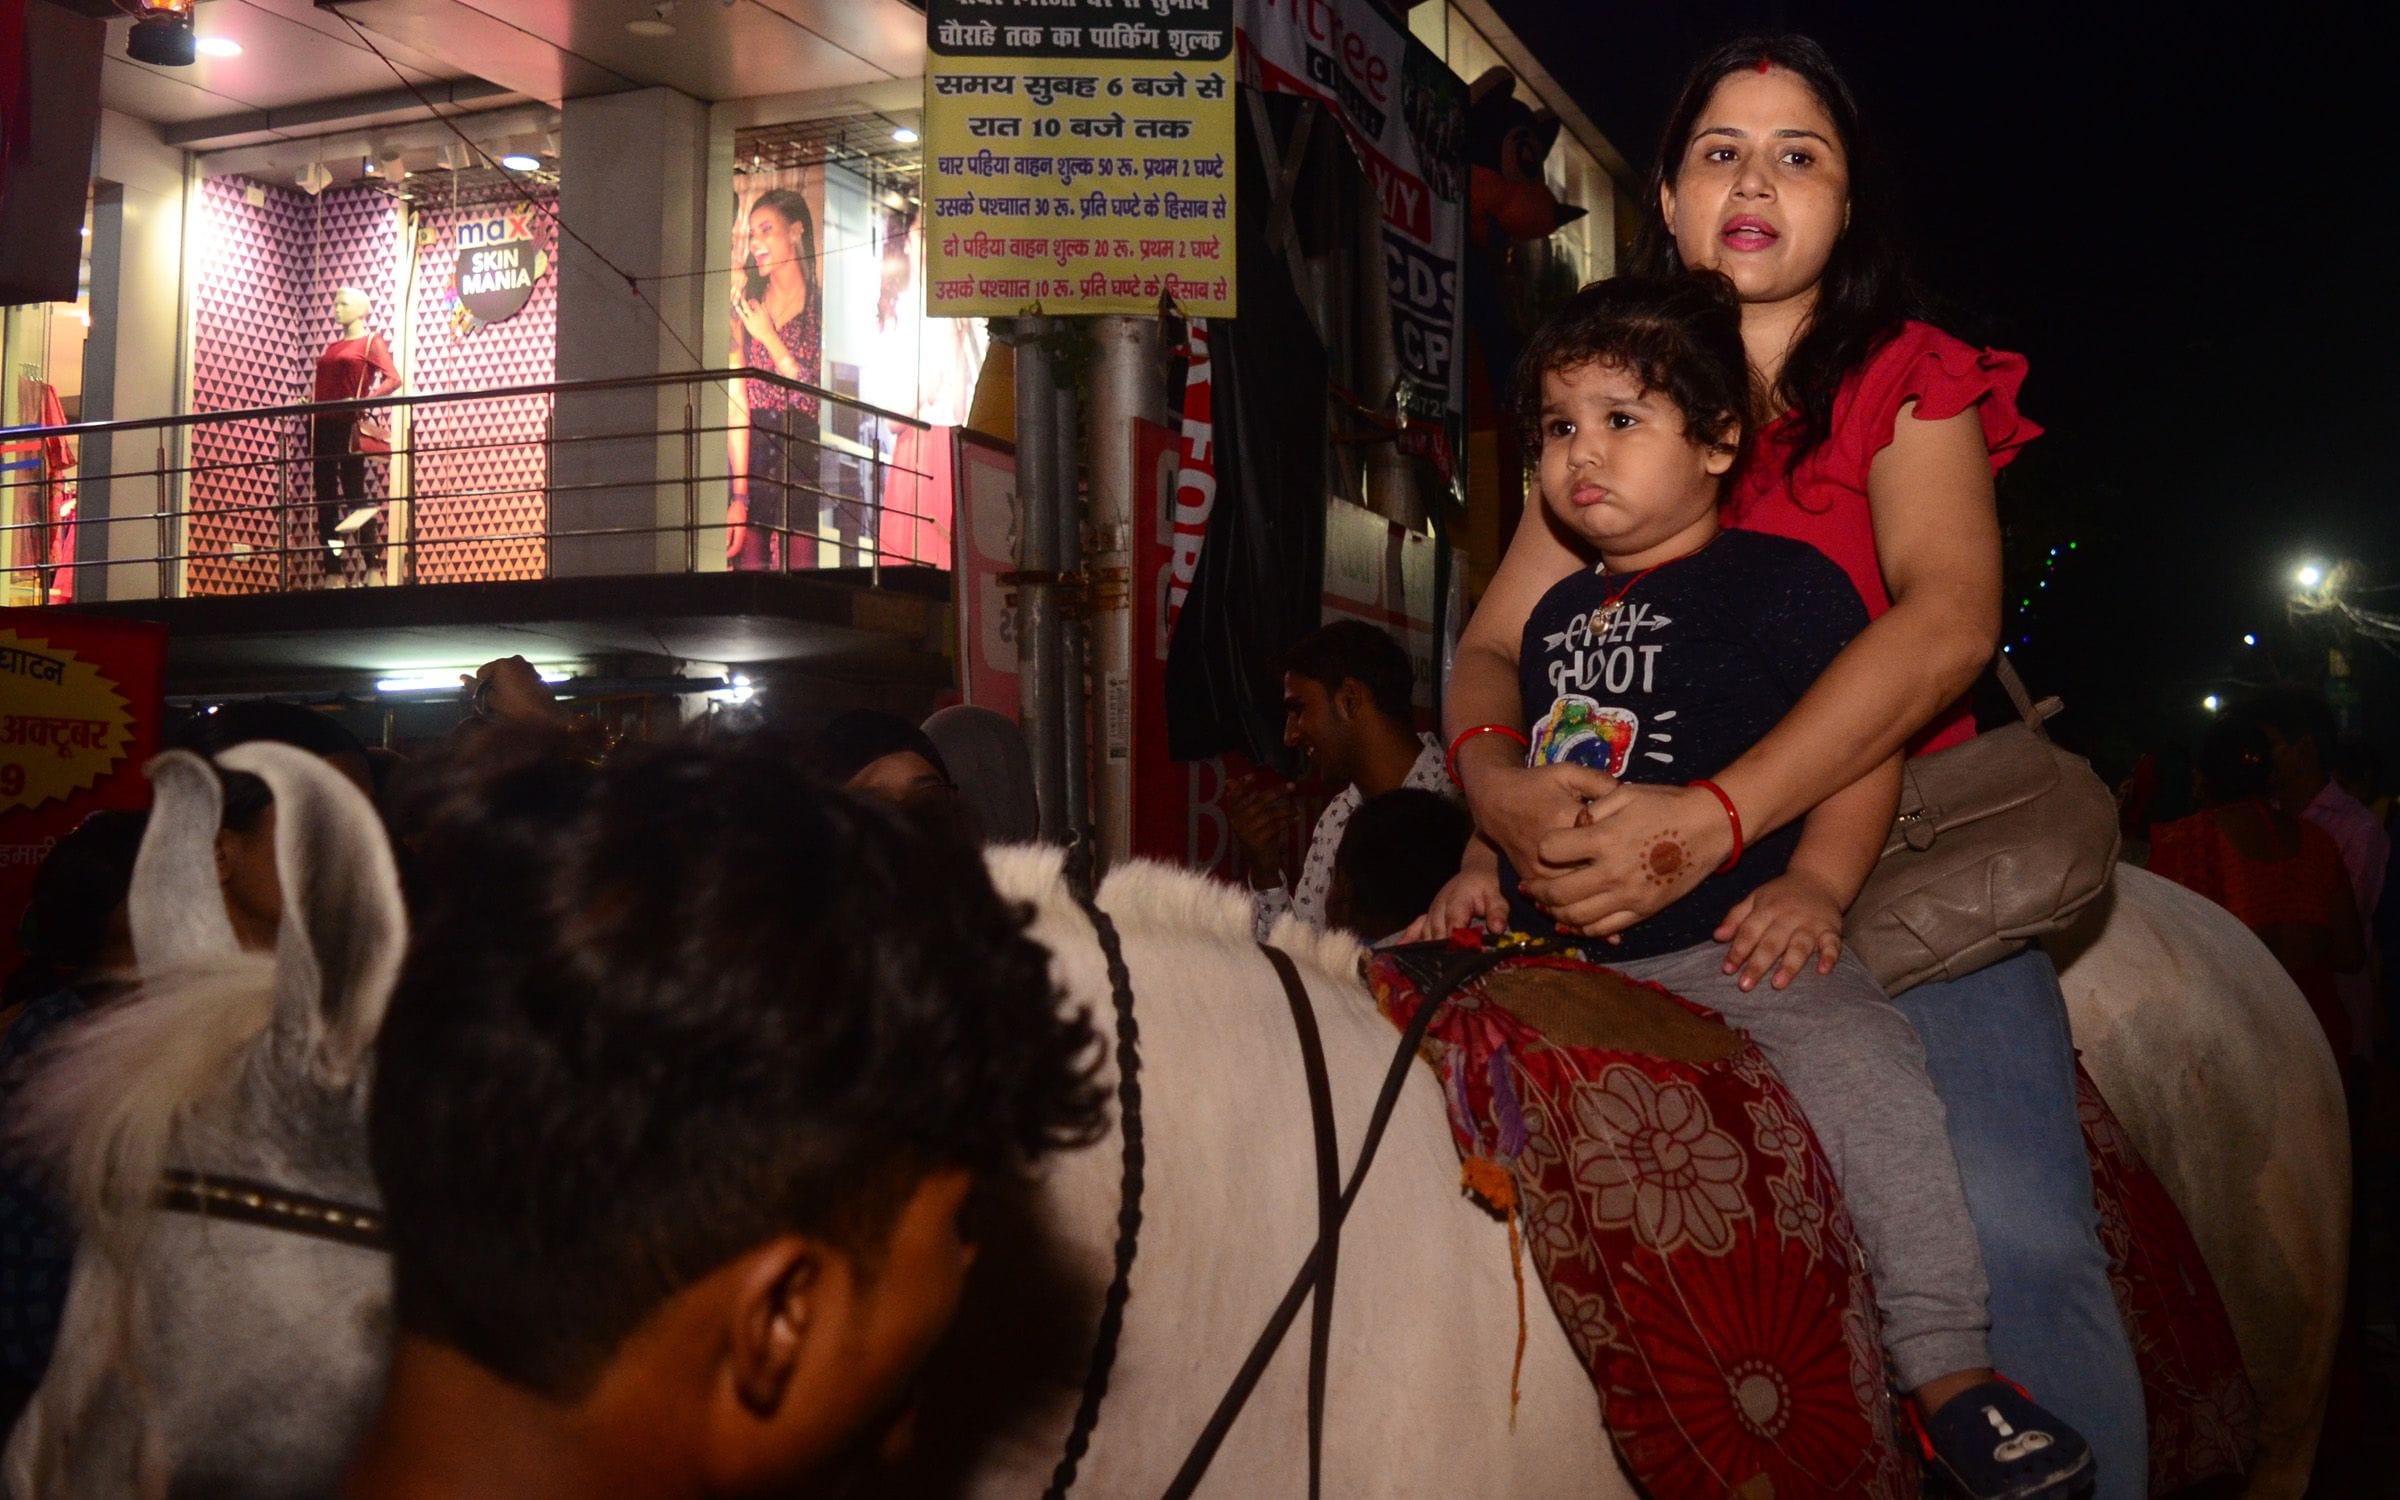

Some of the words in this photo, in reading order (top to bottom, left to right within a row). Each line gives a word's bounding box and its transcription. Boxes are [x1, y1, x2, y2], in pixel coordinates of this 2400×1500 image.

[938, 19, 997, 46] चौराहे
[1004, 26, 1043, 47] तक
[1050, 27, 1082, 47] का
[1168, 30, 1222, 57] शुल्क
[934, 75, 1016, 95] समय
[1023, 76, 1099, 105] सुबह
[1107, 78, 1123, 96] 6
[1132, 71, 1187, 97] बजे
[1195, 72, 1225, 98] से
[969, 118, 1022, 136] रात
[1032, 118, 1060, 137] 10
[1069, 112, 1125, 137] बजे
[1134, 120, 1192, 138] तक
[938, 157, 964, 175] चार
[967, 149, 1010, 177] पहिया
[1013, 157, 1053, 177] वाहन
[1057, 157, 1095, 185] शुल्क
[1098, 158, 1113, 176] 50
[1143, 158, 1178, 180] प्रथम
[1183, 159, 1190, 177] 2
[1194, 153, 1224, 178] घण्टे
[935, 191, 975, 216] उसके
[1035, 198, 1049, 216] 30
[1080, 191, 1107, 220] प्रति
[1111, 192, 1140, 217] घण्टे
[1144, 193, 1160, 217] के
[1213, 194, 1226, 219] से
[458, 216, 531, 245] max
[471, 248, 520, 274] SKIN
[943, 233, 959, 257] दो
[964, 231, 1006, 258] पहिया
[1010, 239, 1048, 258] वाहन
[1053, 239, 1090, 267] शुल्क
[1139, 239, 1174, 261] प्रथम
[1179, 240, 1186, 258] 2
[1190, 234, 1220, 259] घण्टे
[462, 268, 531, 295] MANIA
[936, 273, 975, 299] उसके
[1035, 280, 1049, 297] 10
[1080, 272, 1107, 300] प्रति
[1111, 274, 1140, 297] घण्टे
[1144, 274, 1160, 297] के
[1214, 276, 1227, 300] से
